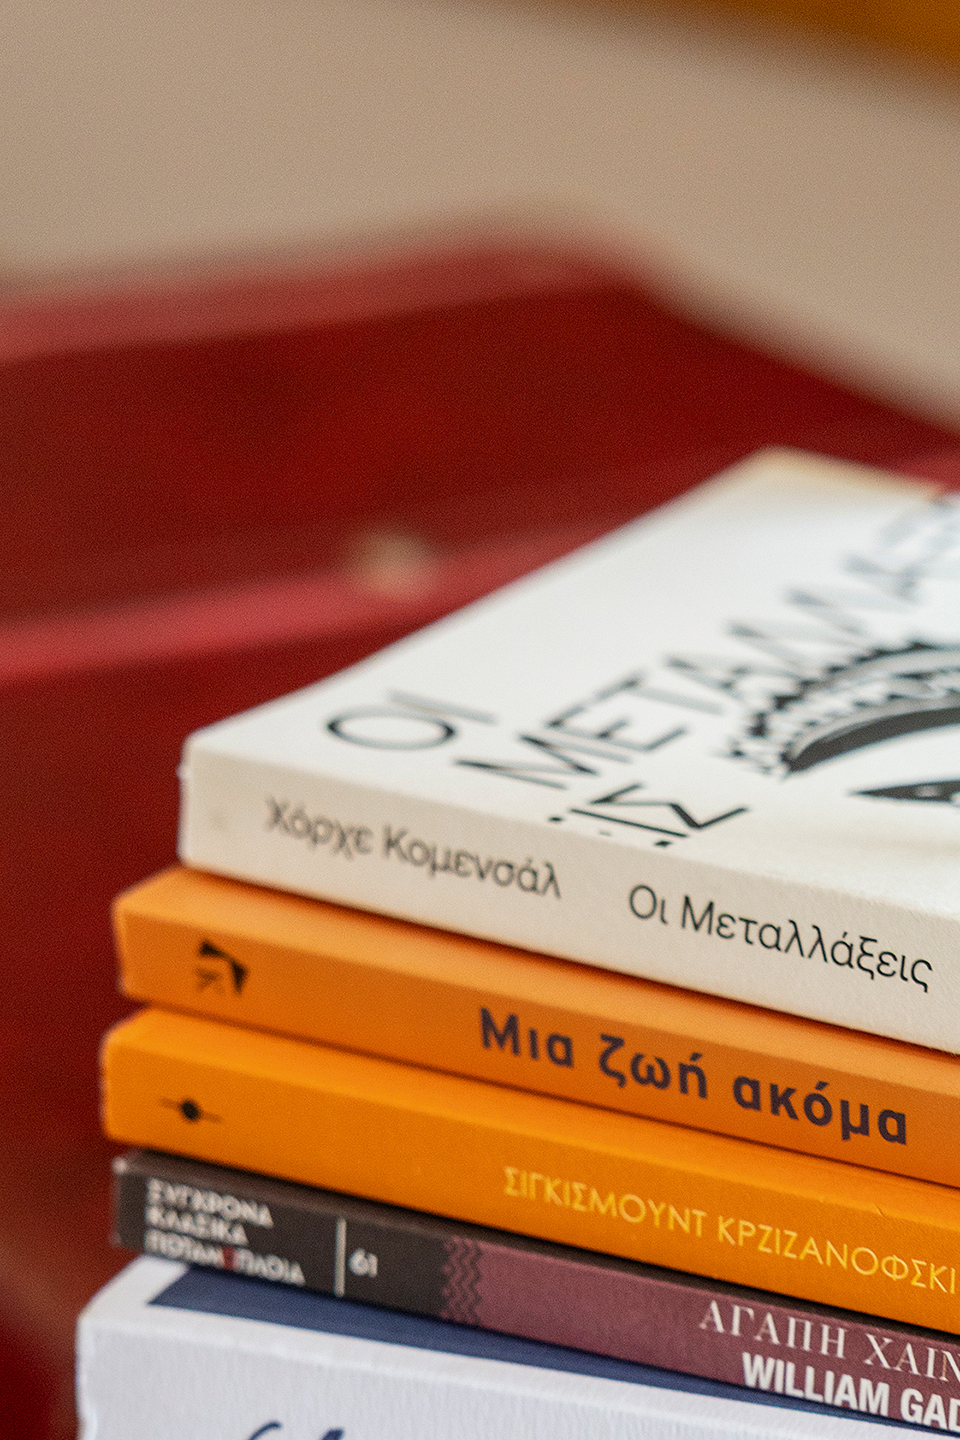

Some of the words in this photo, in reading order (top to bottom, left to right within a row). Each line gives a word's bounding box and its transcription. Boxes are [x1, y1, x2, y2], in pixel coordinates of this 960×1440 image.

[266, 797, 373, 860] Χόρχε
[381, 817, 563, 900] Κομενσάλ
[629, 884, 669, 925] Οι
[682, 895, 932, 992] Μεταλλάξεις
[478, 1007, 575, 1068] Μια
[599, 1032, 708, 1098] ζωή
[733, 1076, 907, 1145] ακόμα
[350, 1248, 378, 1277] 61
[503, 1165, 706, 1238] ΣΙΓΚΙΣΜΟΥΝΤ
[718, 1216, 956, 1295] ΚΡΖΙΖΑΝΟΦΣΚΙ
[699, 1300, 847, 1360] ΑΓΑΠΗ
[741, 1352, 890, 1417] WILLIAM
